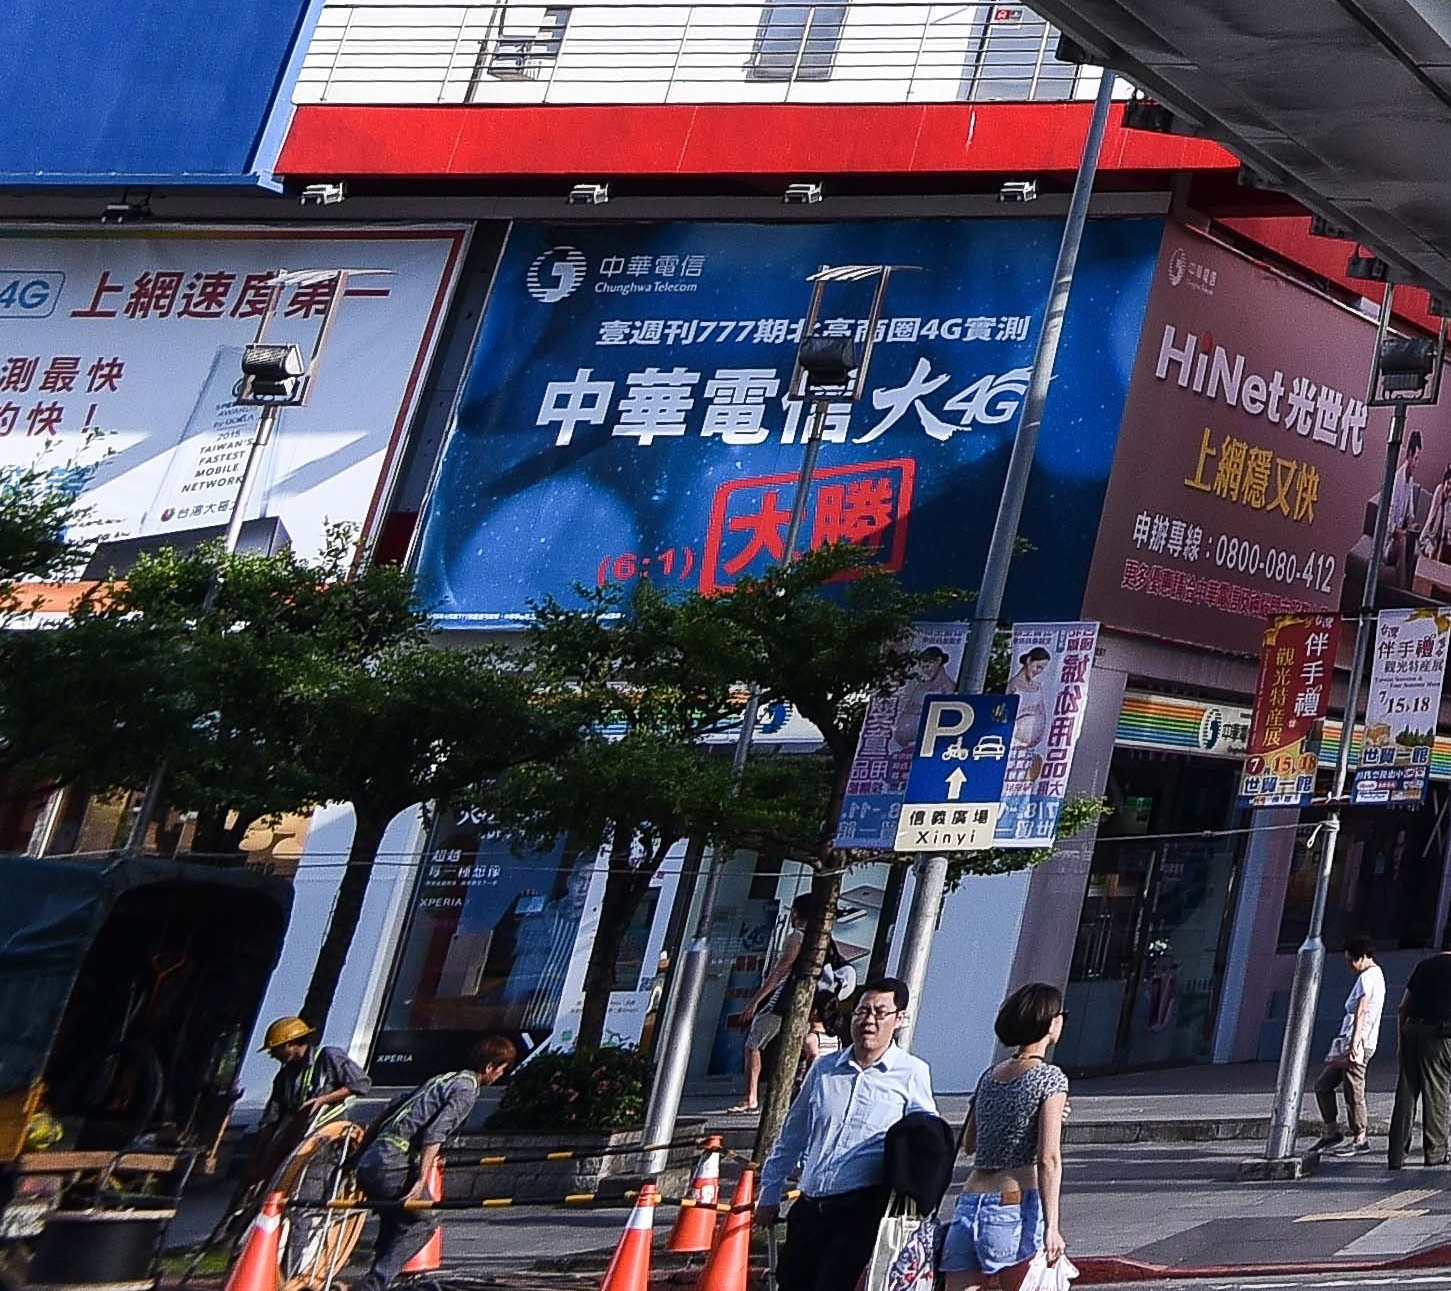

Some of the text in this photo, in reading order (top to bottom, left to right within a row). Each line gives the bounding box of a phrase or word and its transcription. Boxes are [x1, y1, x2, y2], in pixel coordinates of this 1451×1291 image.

[600, 255, 706, 278] 中華電信
[70, 270, 390, 319] 上網速度第一
[594, 281, 698, 294] Chunghwa Telecom
[200, 437, 255, 454] TAIWAN'S
[199, 450, 246, 466] FASTEST
[194, 463, 240, 478] MOBILE
[1184, 427, 1320, 524] 上網穩又快
[1294, 632, 1329, 717] 伴手禮
[1262, 646, 1295, 747] 觀光特產展
[919, 700, 975, 758] P
[909, 809, 989, 827] 信義廣場
[915, 829, 976, 844] Xinyi
[420, 898, 463, 907] XPERIA
[376, 1054, 413, 1063] XPERIA
